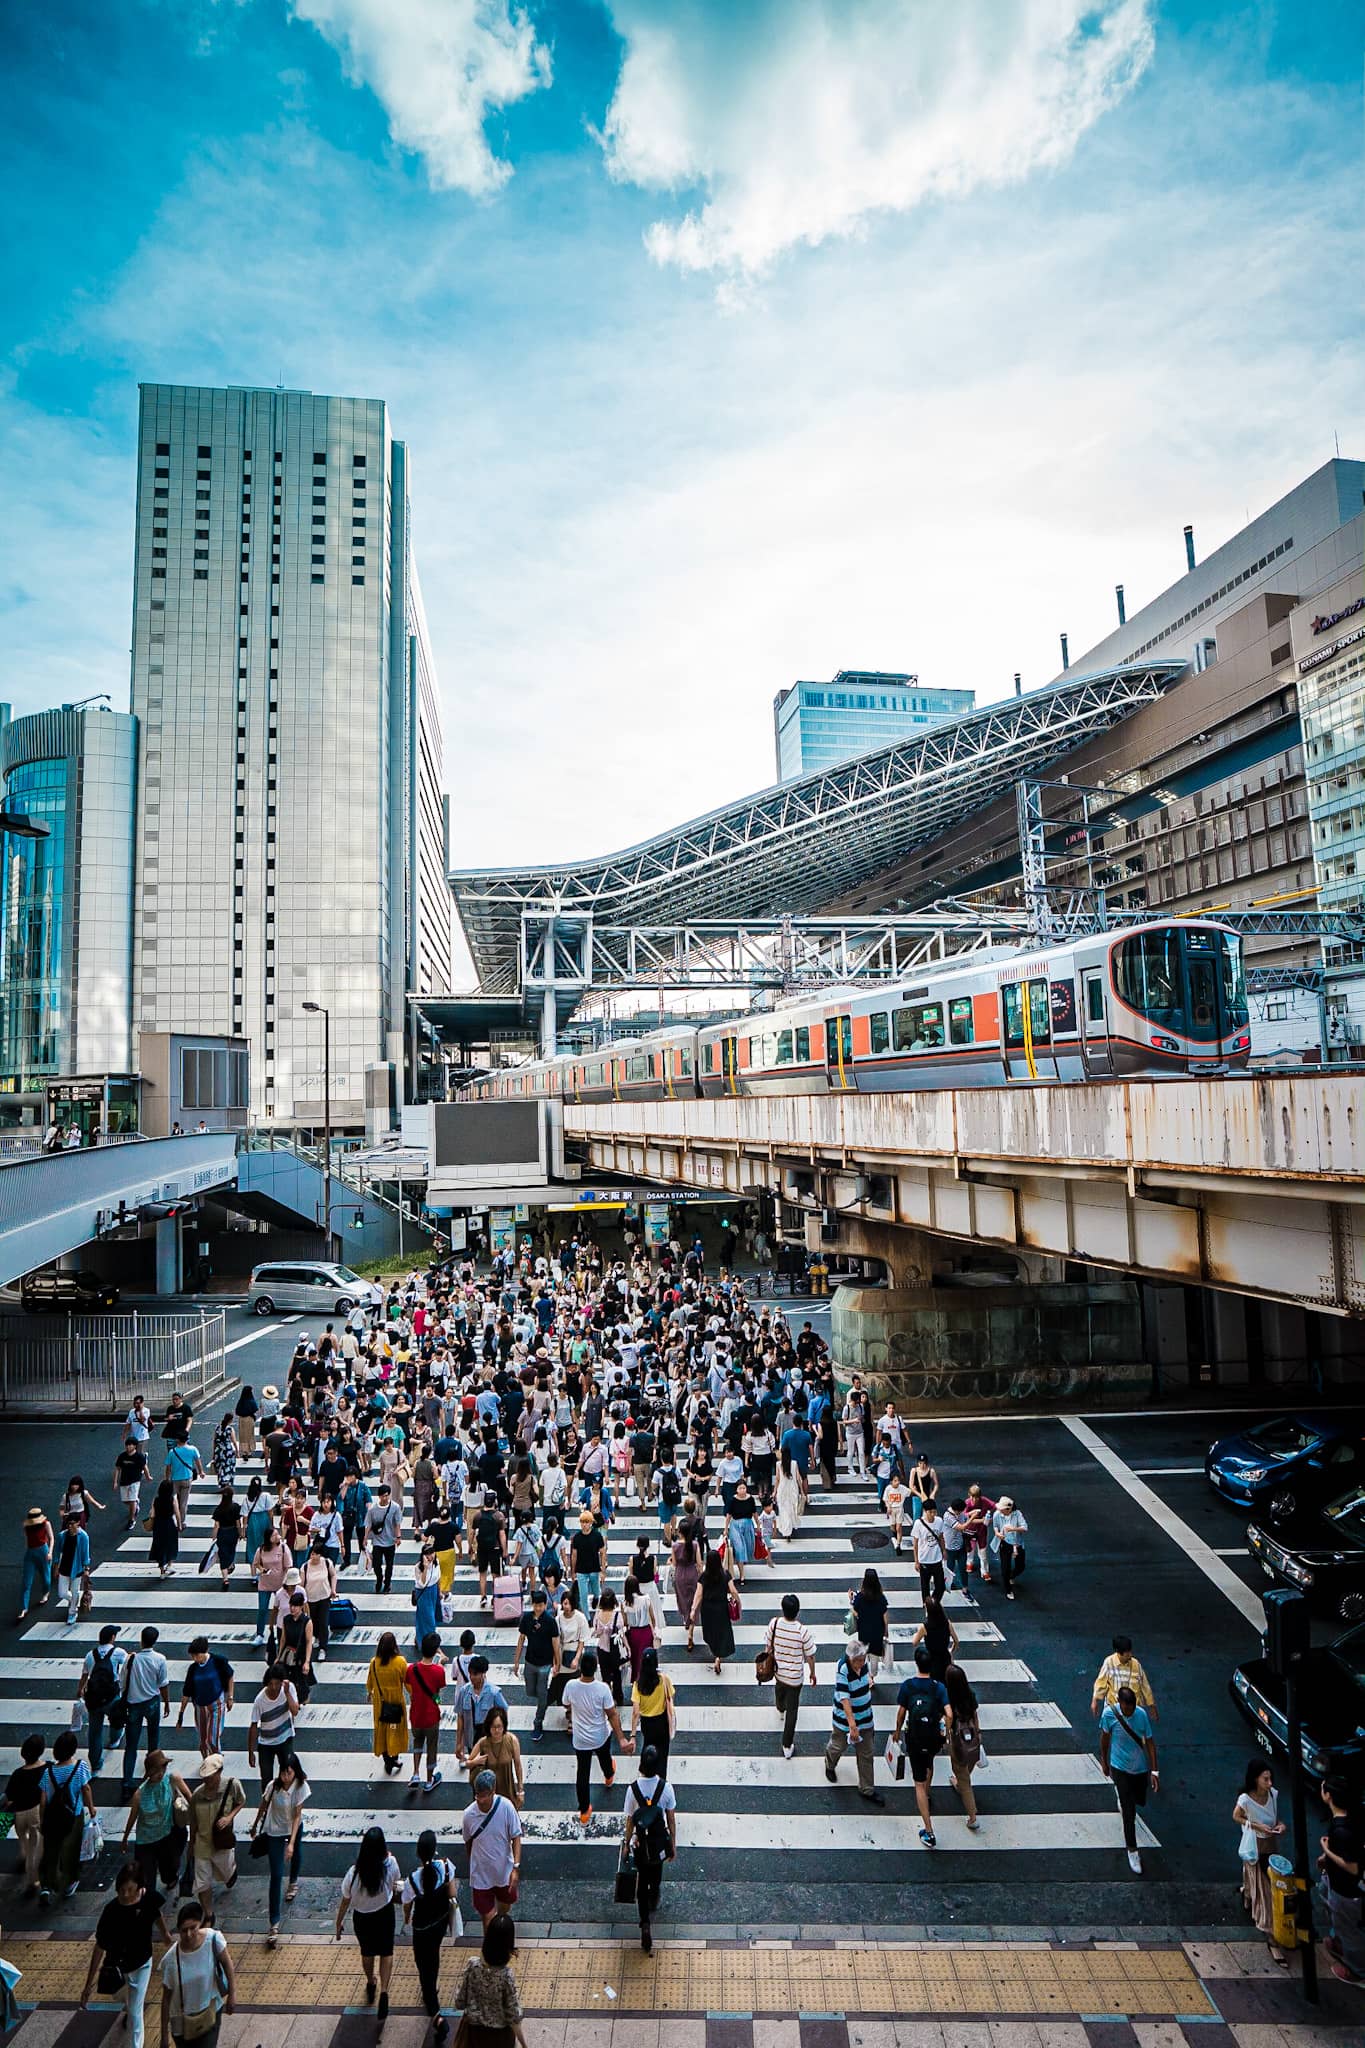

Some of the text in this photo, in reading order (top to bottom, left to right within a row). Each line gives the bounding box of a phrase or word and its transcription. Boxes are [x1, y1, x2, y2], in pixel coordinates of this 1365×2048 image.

[1300, 647, 1333, 670] KONAMI
[579, 1191, 595, 1201] JR
[599, 1191, 633, 1200] 大阪駅
[671, 1191, 700, 1199] STATION
